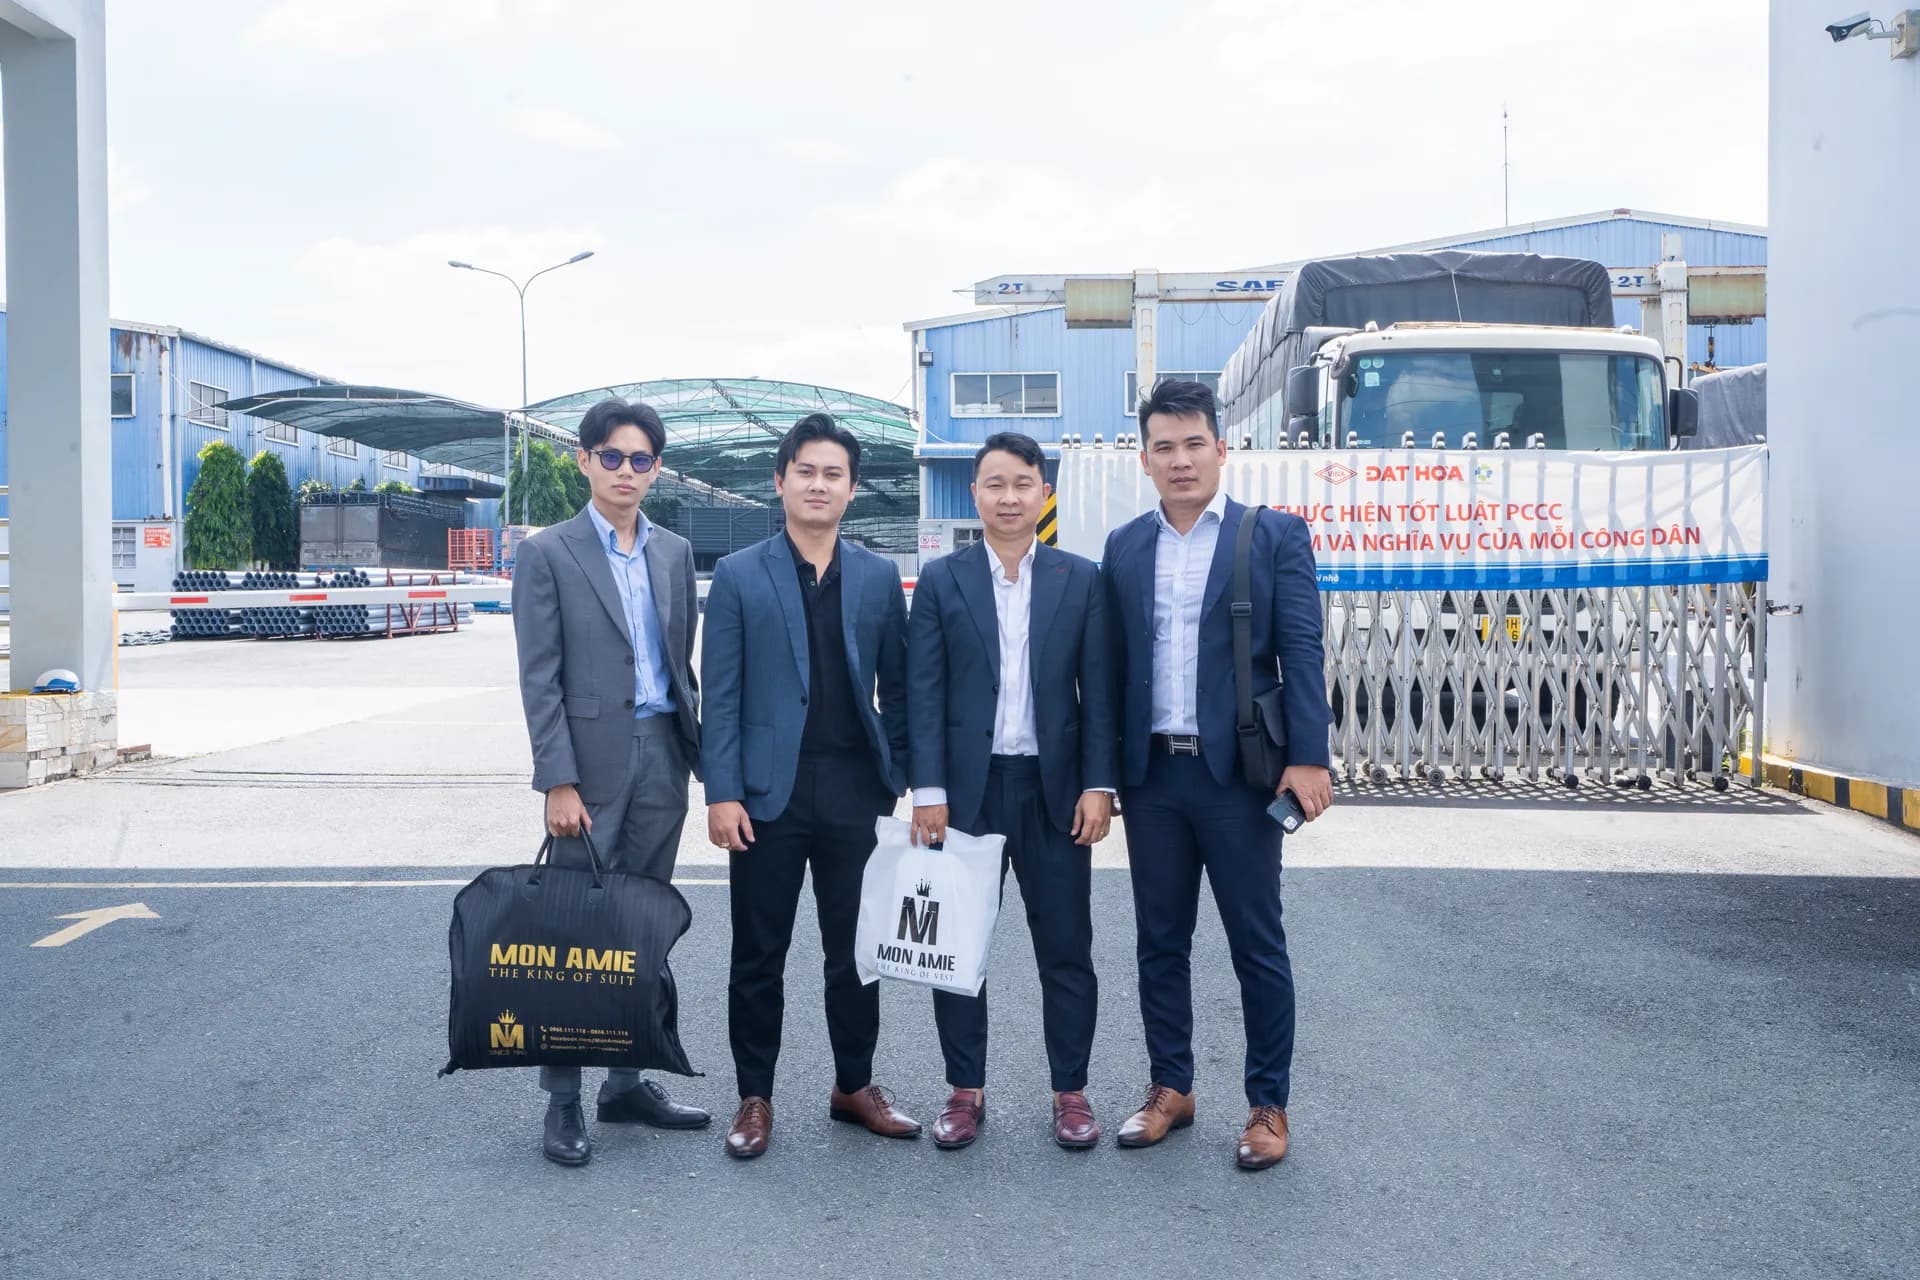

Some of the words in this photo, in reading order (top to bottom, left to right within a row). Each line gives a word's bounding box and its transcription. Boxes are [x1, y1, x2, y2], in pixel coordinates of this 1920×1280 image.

[998, 283, 1024, 295] 2T
[1617, 276, 1645, 287] 2T
[1327, 470, 1345, 478] VINA
[1340, 501, 1392, 527] HIỆN
[1396, 499, 1439, 523] TỐT
[1445, 500, 1500, 526] LUẬT
[1506, 503, 1562, 521] PCCC
[1327, 531, 1356, 551] VÀ
[1363, 529, 1434, 551] NGHĨA
[1440, 533, 1470, 556] VỤ
[1477, 528, 1523, 551] CỦA
[1530, 525, 1574, 550] MỖI
[1580, 528, 1645, 548] CÔNG
[1652, 523, 1700, 546] DÂN
[490, 943, 556, 968] MON
[565, 947, 637, 973] AMIE
[877, 943, 913, 965] MON
[917, 952, 956, 972] AMIE
[488, 967, 519, 979] THE
[527, 969, 565, 982] KING
[573, 972, 593, 983] OF
[600, 973, 636, 986] SUIT
[875, 962, 891, 970] THE
[895, 967, 916, 976] KING
[920, 971, 930, 979] OF
[934, 972, 954, 982] VEST
